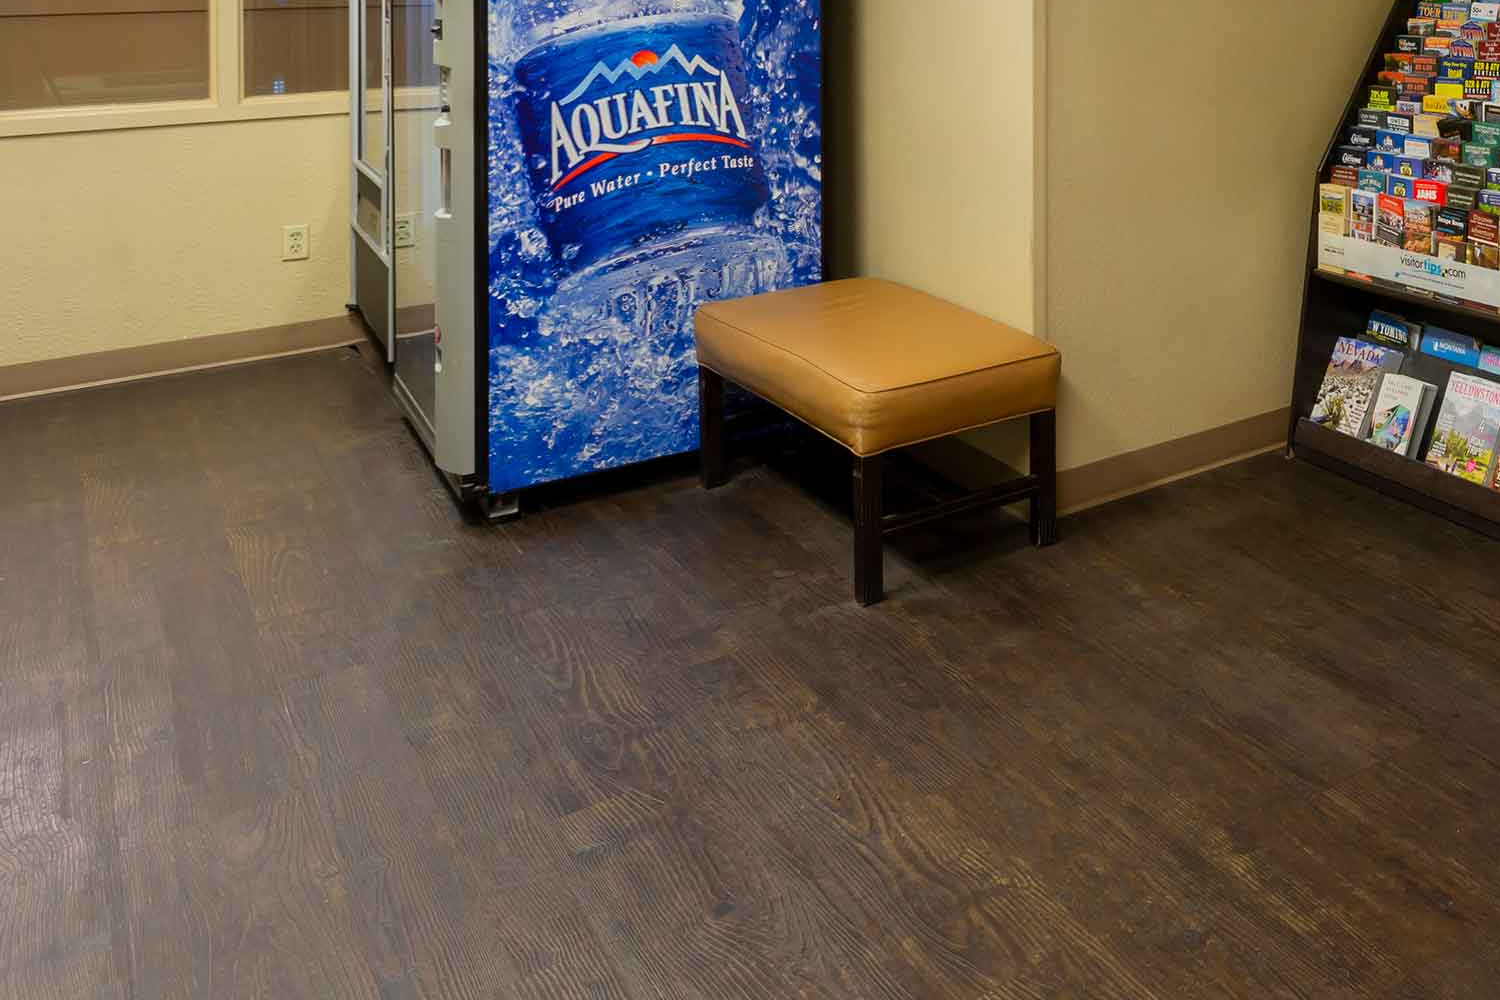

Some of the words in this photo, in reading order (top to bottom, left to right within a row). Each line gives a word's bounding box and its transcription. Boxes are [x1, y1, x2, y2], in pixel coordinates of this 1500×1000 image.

[549, 69, 748, 185] AQUAFINA
[554, 190, 586, 213] Pure
[590, 171, 641, 198] Water
[659, 156, 718, 179] Perfect
[720, 153, 755, 170] Taste
[1371, 320, 1409, 344] WYOMING
[1337, 340, 1385, 365] NEVADA
[1439, 341, 1467, 355] MONTANA
